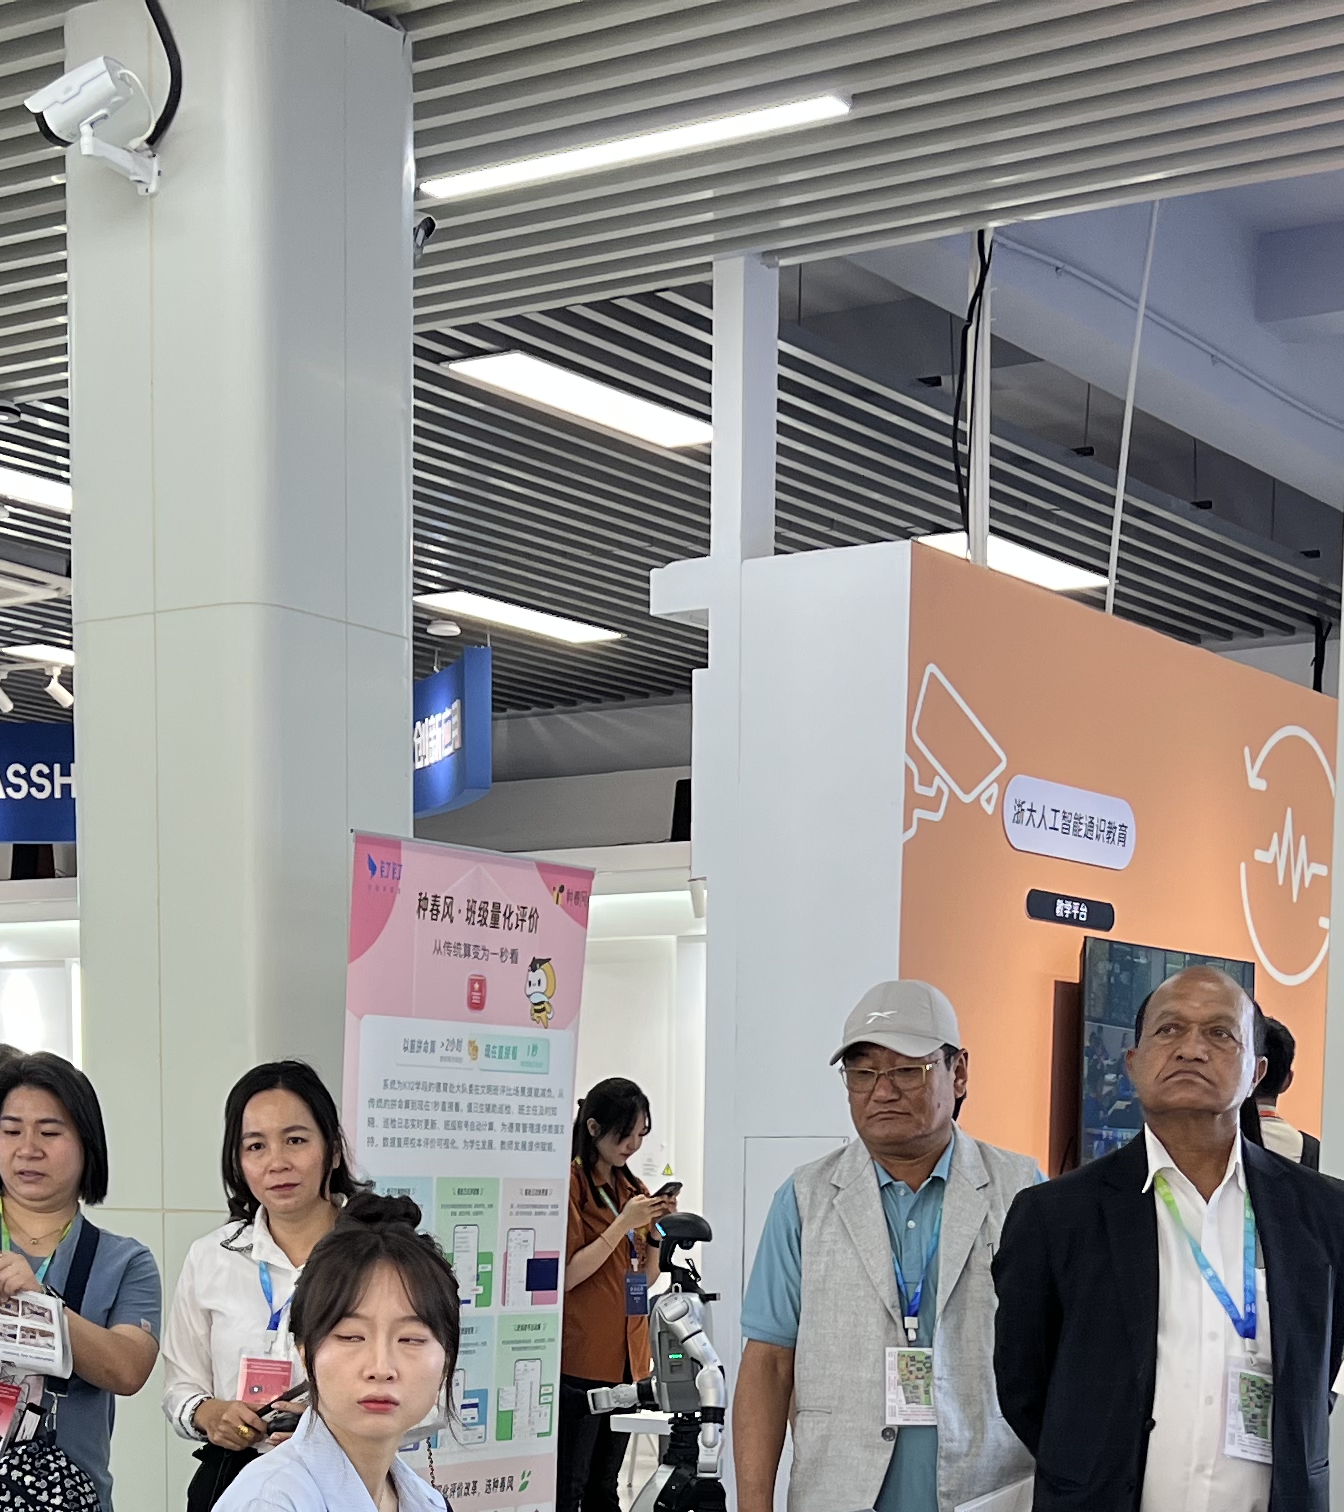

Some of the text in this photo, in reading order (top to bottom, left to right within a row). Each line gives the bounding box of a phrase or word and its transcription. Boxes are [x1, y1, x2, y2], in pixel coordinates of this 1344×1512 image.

[1011, 798, 1130, 849] 浙大人工智能通识教育
[1055, 898, 1088, 922] 教学平台
